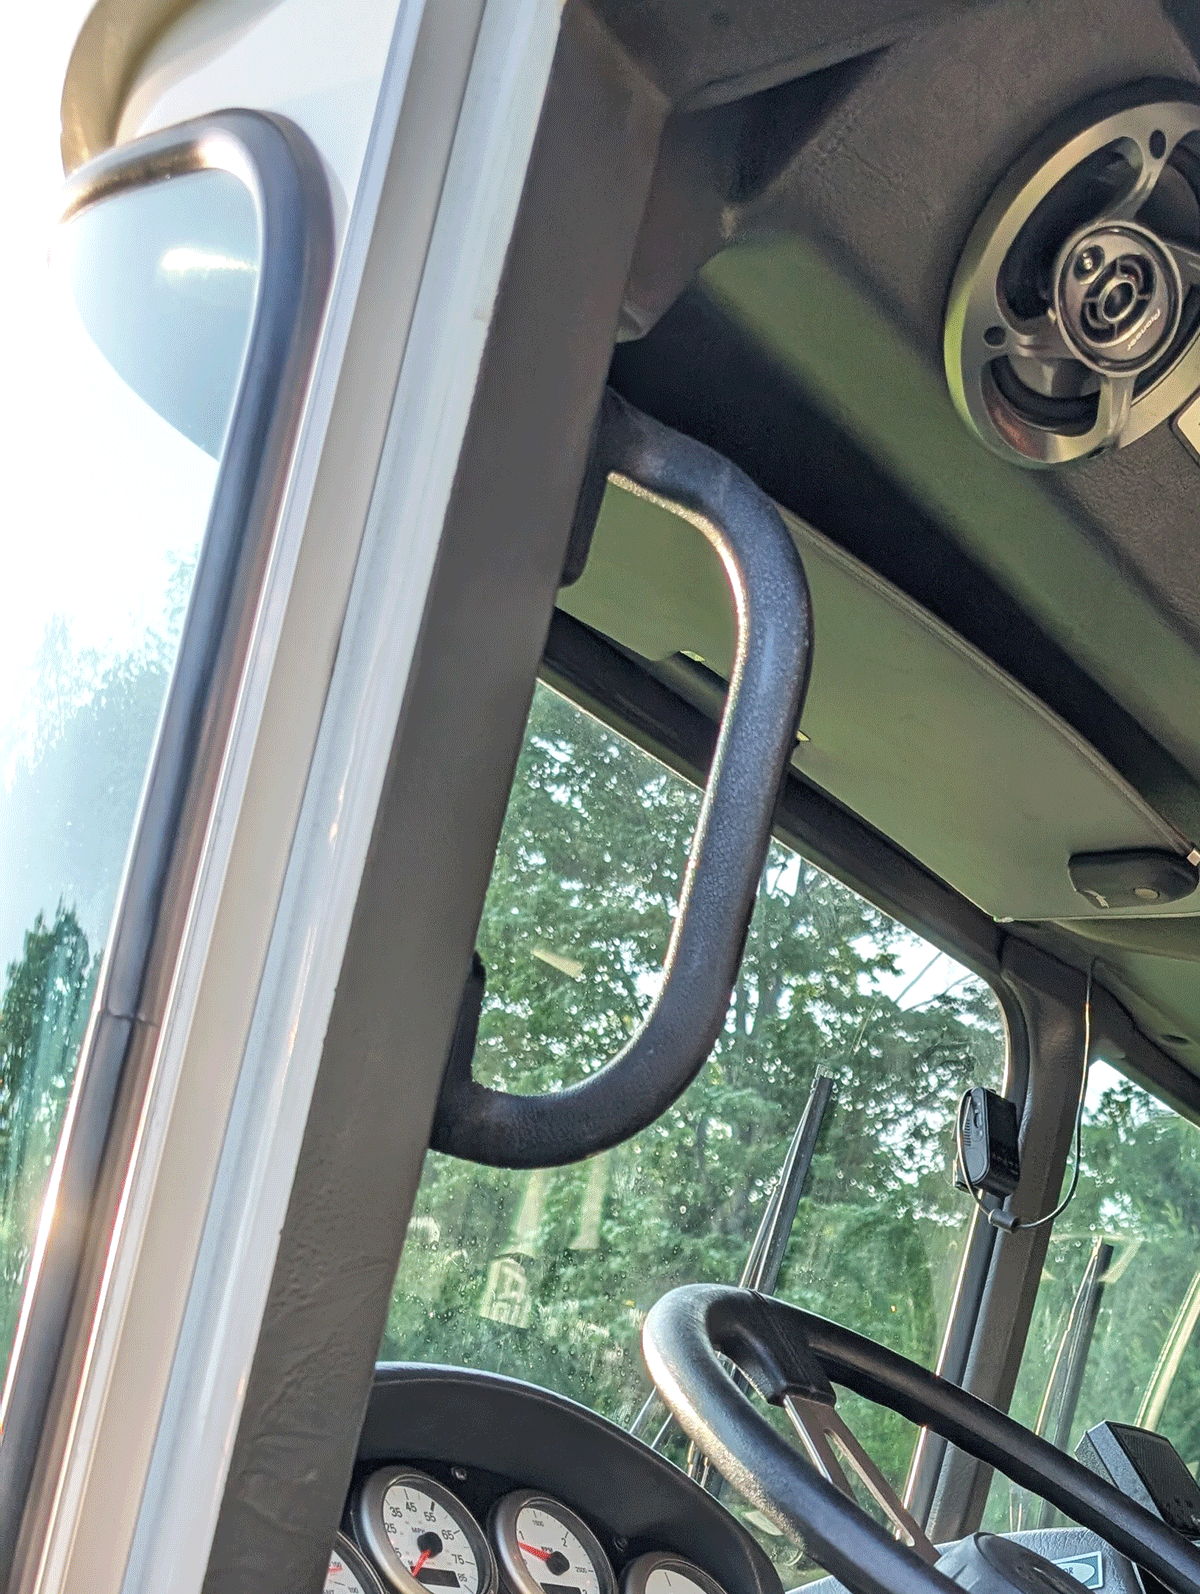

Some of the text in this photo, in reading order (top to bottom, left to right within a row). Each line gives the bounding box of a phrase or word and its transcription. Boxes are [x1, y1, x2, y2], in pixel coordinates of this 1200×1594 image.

[1128, 308, 1161, 351] Pioneer
[389, 1506, 402, 1518] 35
[405, 1501, 417, 1513] 45
[423, 1511, 437, 1523] 55
[385, 1522, 397, 1534] 25
[441, 1529, 455, 1541] 65
[561, 1537, 568, 1548] 2
[451, 1553, 465, 1565] 75
